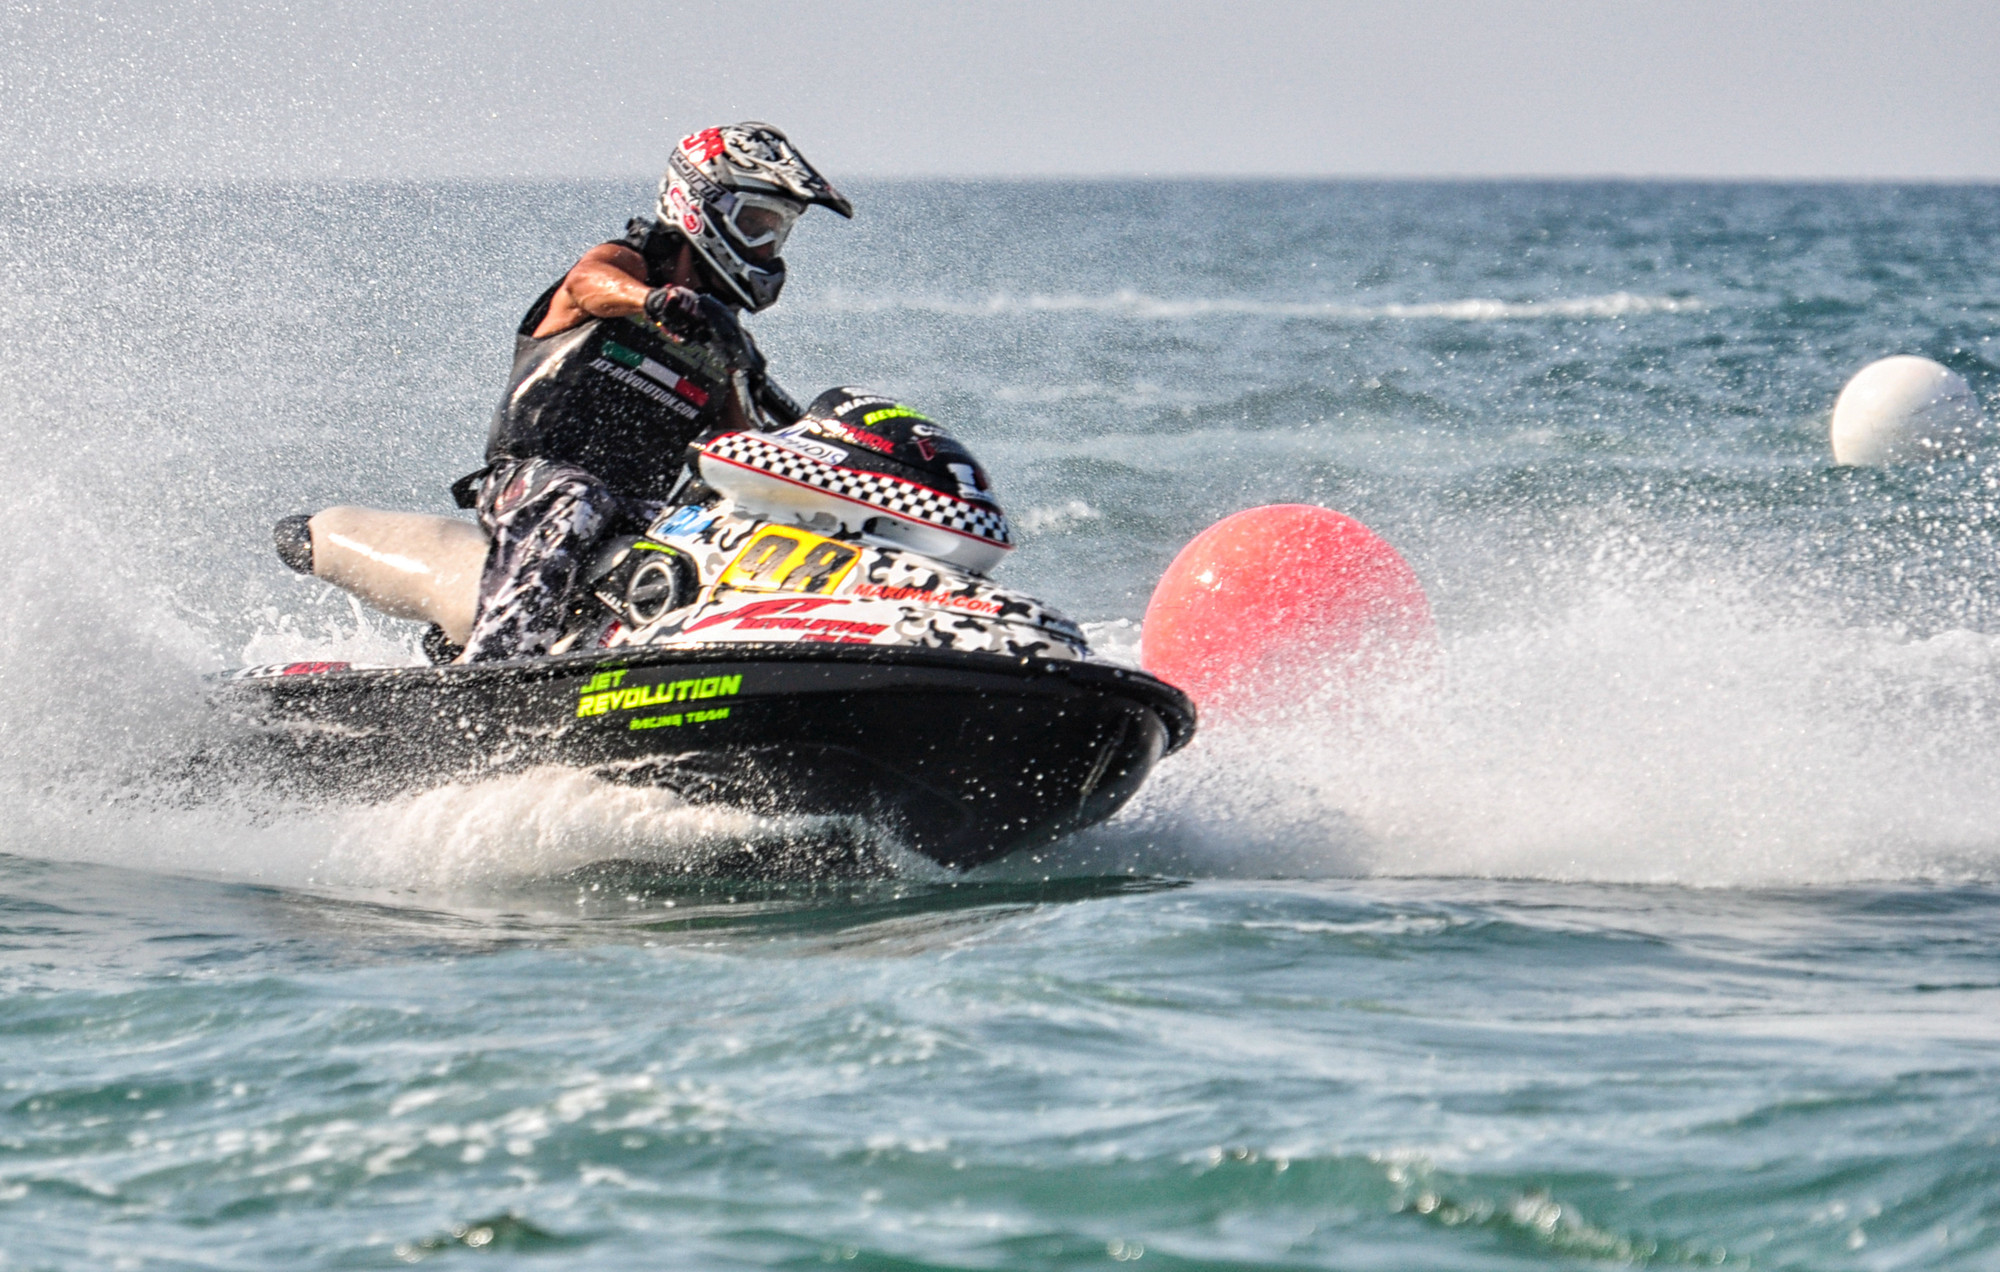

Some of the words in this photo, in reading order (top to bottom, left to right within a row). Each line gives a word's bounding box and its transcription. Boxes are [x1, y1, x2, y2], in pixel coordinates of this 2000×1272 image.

[738, 534, 857, 593] 98
[853, 583, 1004, 615] MARINA4.COM
[732, 618, 891, 636] REVOLUTION
[579, 669, 627, 694] JET
[577, 674, 744, 718] REVOLUTION
[628, 713, 683, 731] RACING
[685, 707, 731, 724] TEAM
